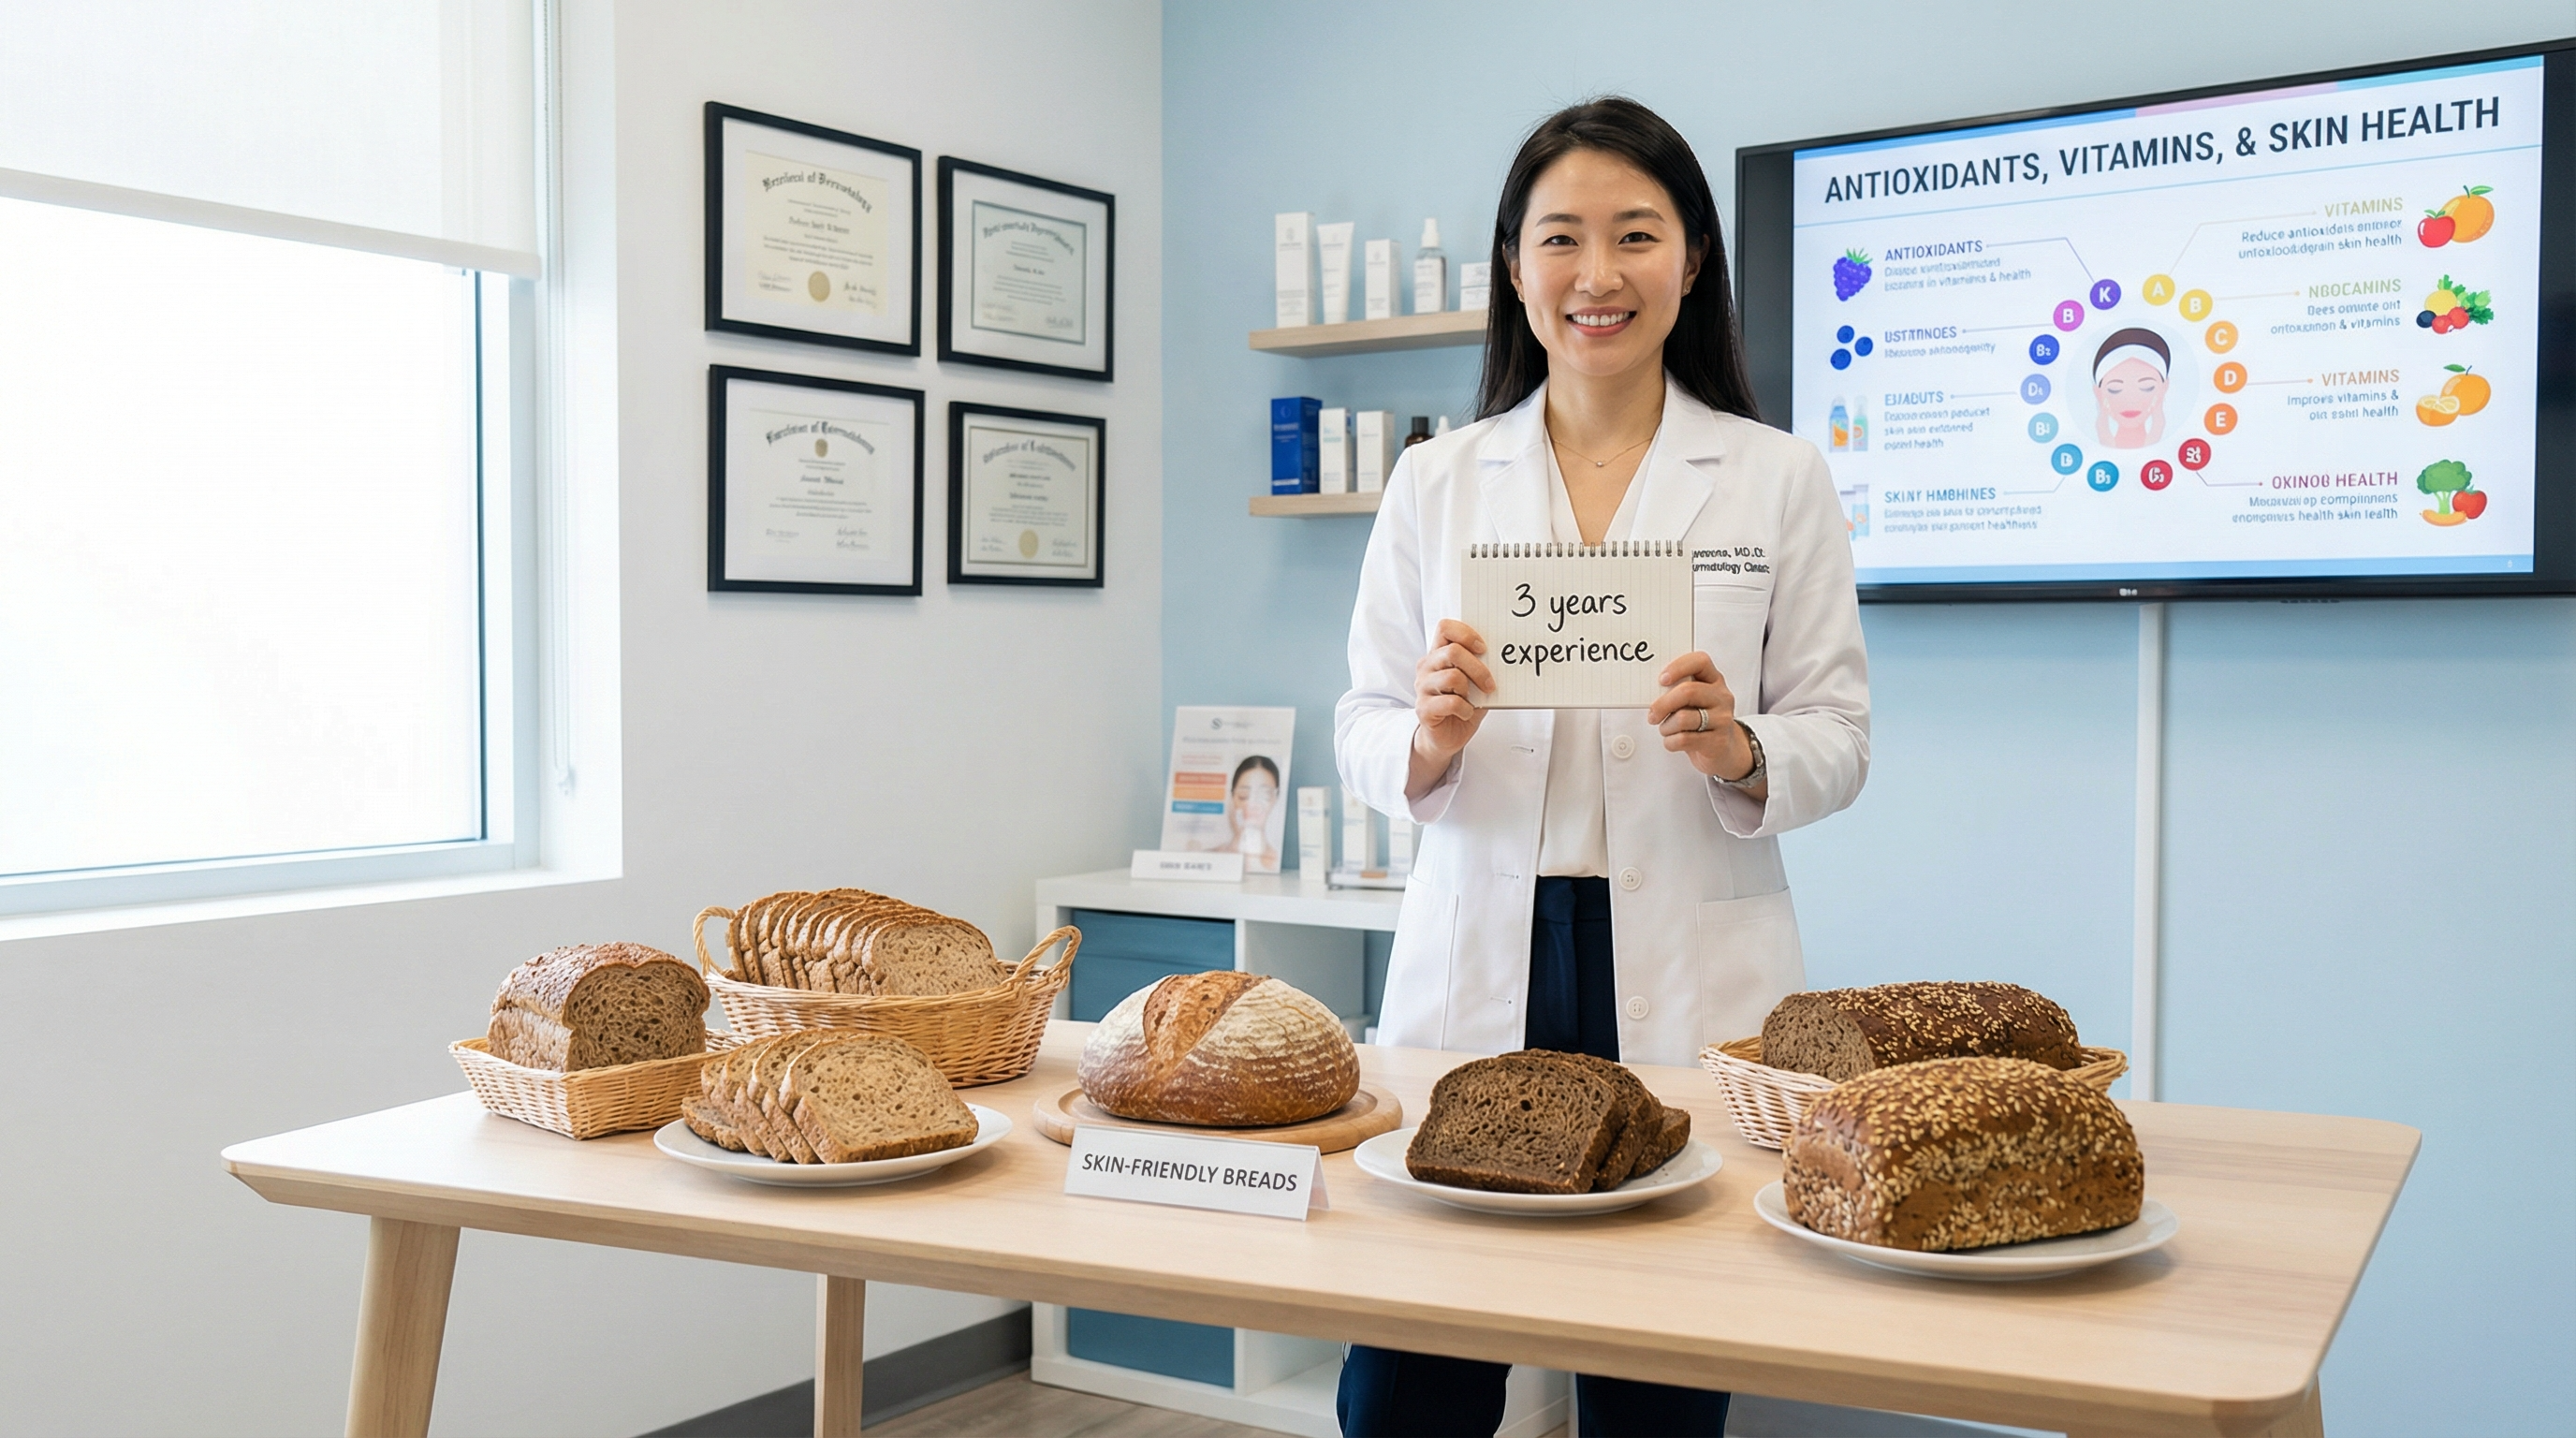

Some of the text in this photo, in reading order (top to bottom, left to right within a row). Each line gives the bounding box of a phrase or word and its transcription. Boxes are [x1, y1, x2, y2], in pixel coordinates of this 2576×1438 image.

[1824, 95, 2500, 203] ANTIOXIDANTS, VITAMINS, & SKIN HEALTH
[2325, 197, 2403, 218] VITAMINS
[2338, 238, 2362, 250] skin
[2365, 234, 2402, 247] health
[1884, 240, 1983, 261] ANTIOXIDANTS
[2099, 286, 2112, 302] K
[2152, 282, 2165, 297] A
[2189, 298, 2202, 313] B
[2062, 308, 2074, 323] B
[2214, 330, 2228, 345] C
[2223, 370, 2236, 386] D
[2321, 369, 2399, 387] VITAMINS
[2391, 389, 2399, 401] &
[2363, 405, 2398, 418] health
[2216, 412, 2227, 428] E
[2335, 471, 2398, 487] HEALTH
[2298, 509, 2334, 521] health
[1511, 583, 1627, 633] 3 years
[1501, 638, 1655, 676] experience
[1081, 1152, 1298, 1192] SKIN-FRIENDLY BREADS
